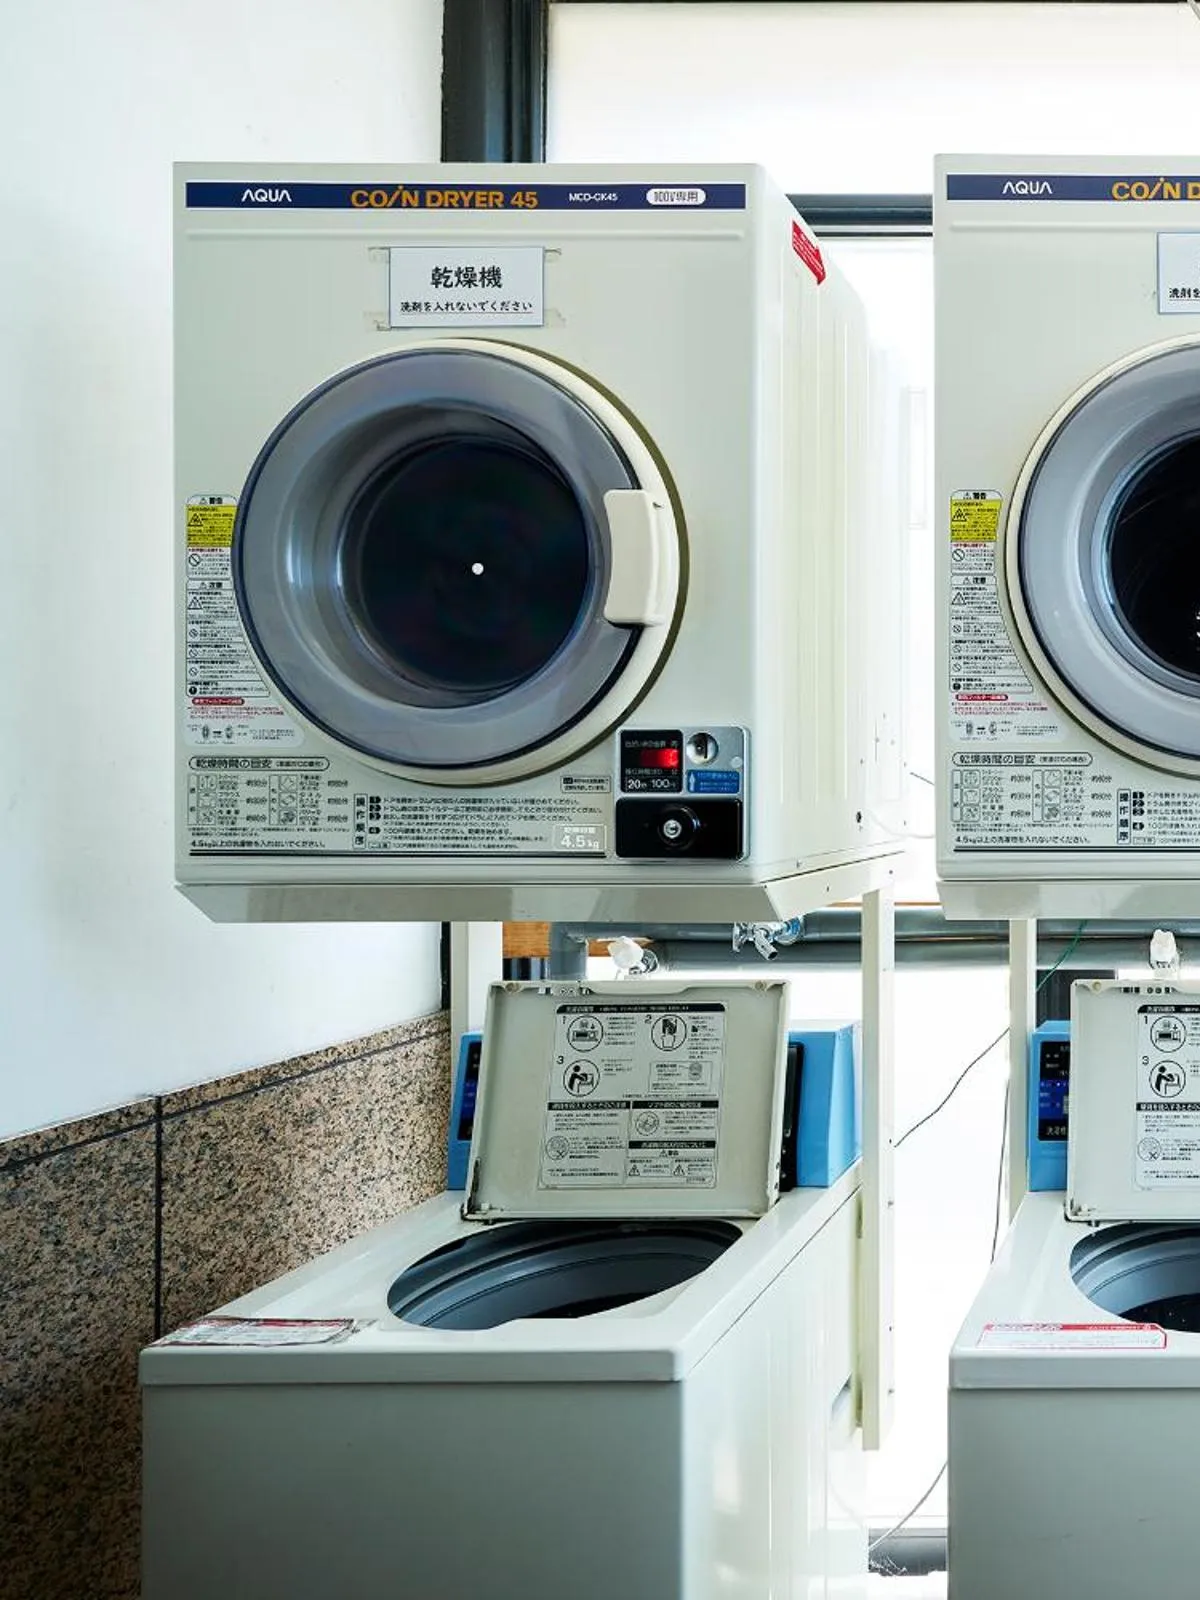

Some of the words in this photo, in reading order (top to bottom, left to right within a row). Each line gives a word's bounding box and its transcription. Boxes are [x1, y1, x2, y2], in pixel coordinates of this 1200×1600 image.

[1002, 181, 1052, 194] AQUA
[241, 188, 292, 202] AQUA
[425, 190, 503, 208] DRYER
[510, 191, 538, 209] 45
[568, 192, 618, 202] MCD-CK45
[430, 265, 503, 289] 乾燥機
[400, 301, 533, 313] 洗剤を入れないでください
